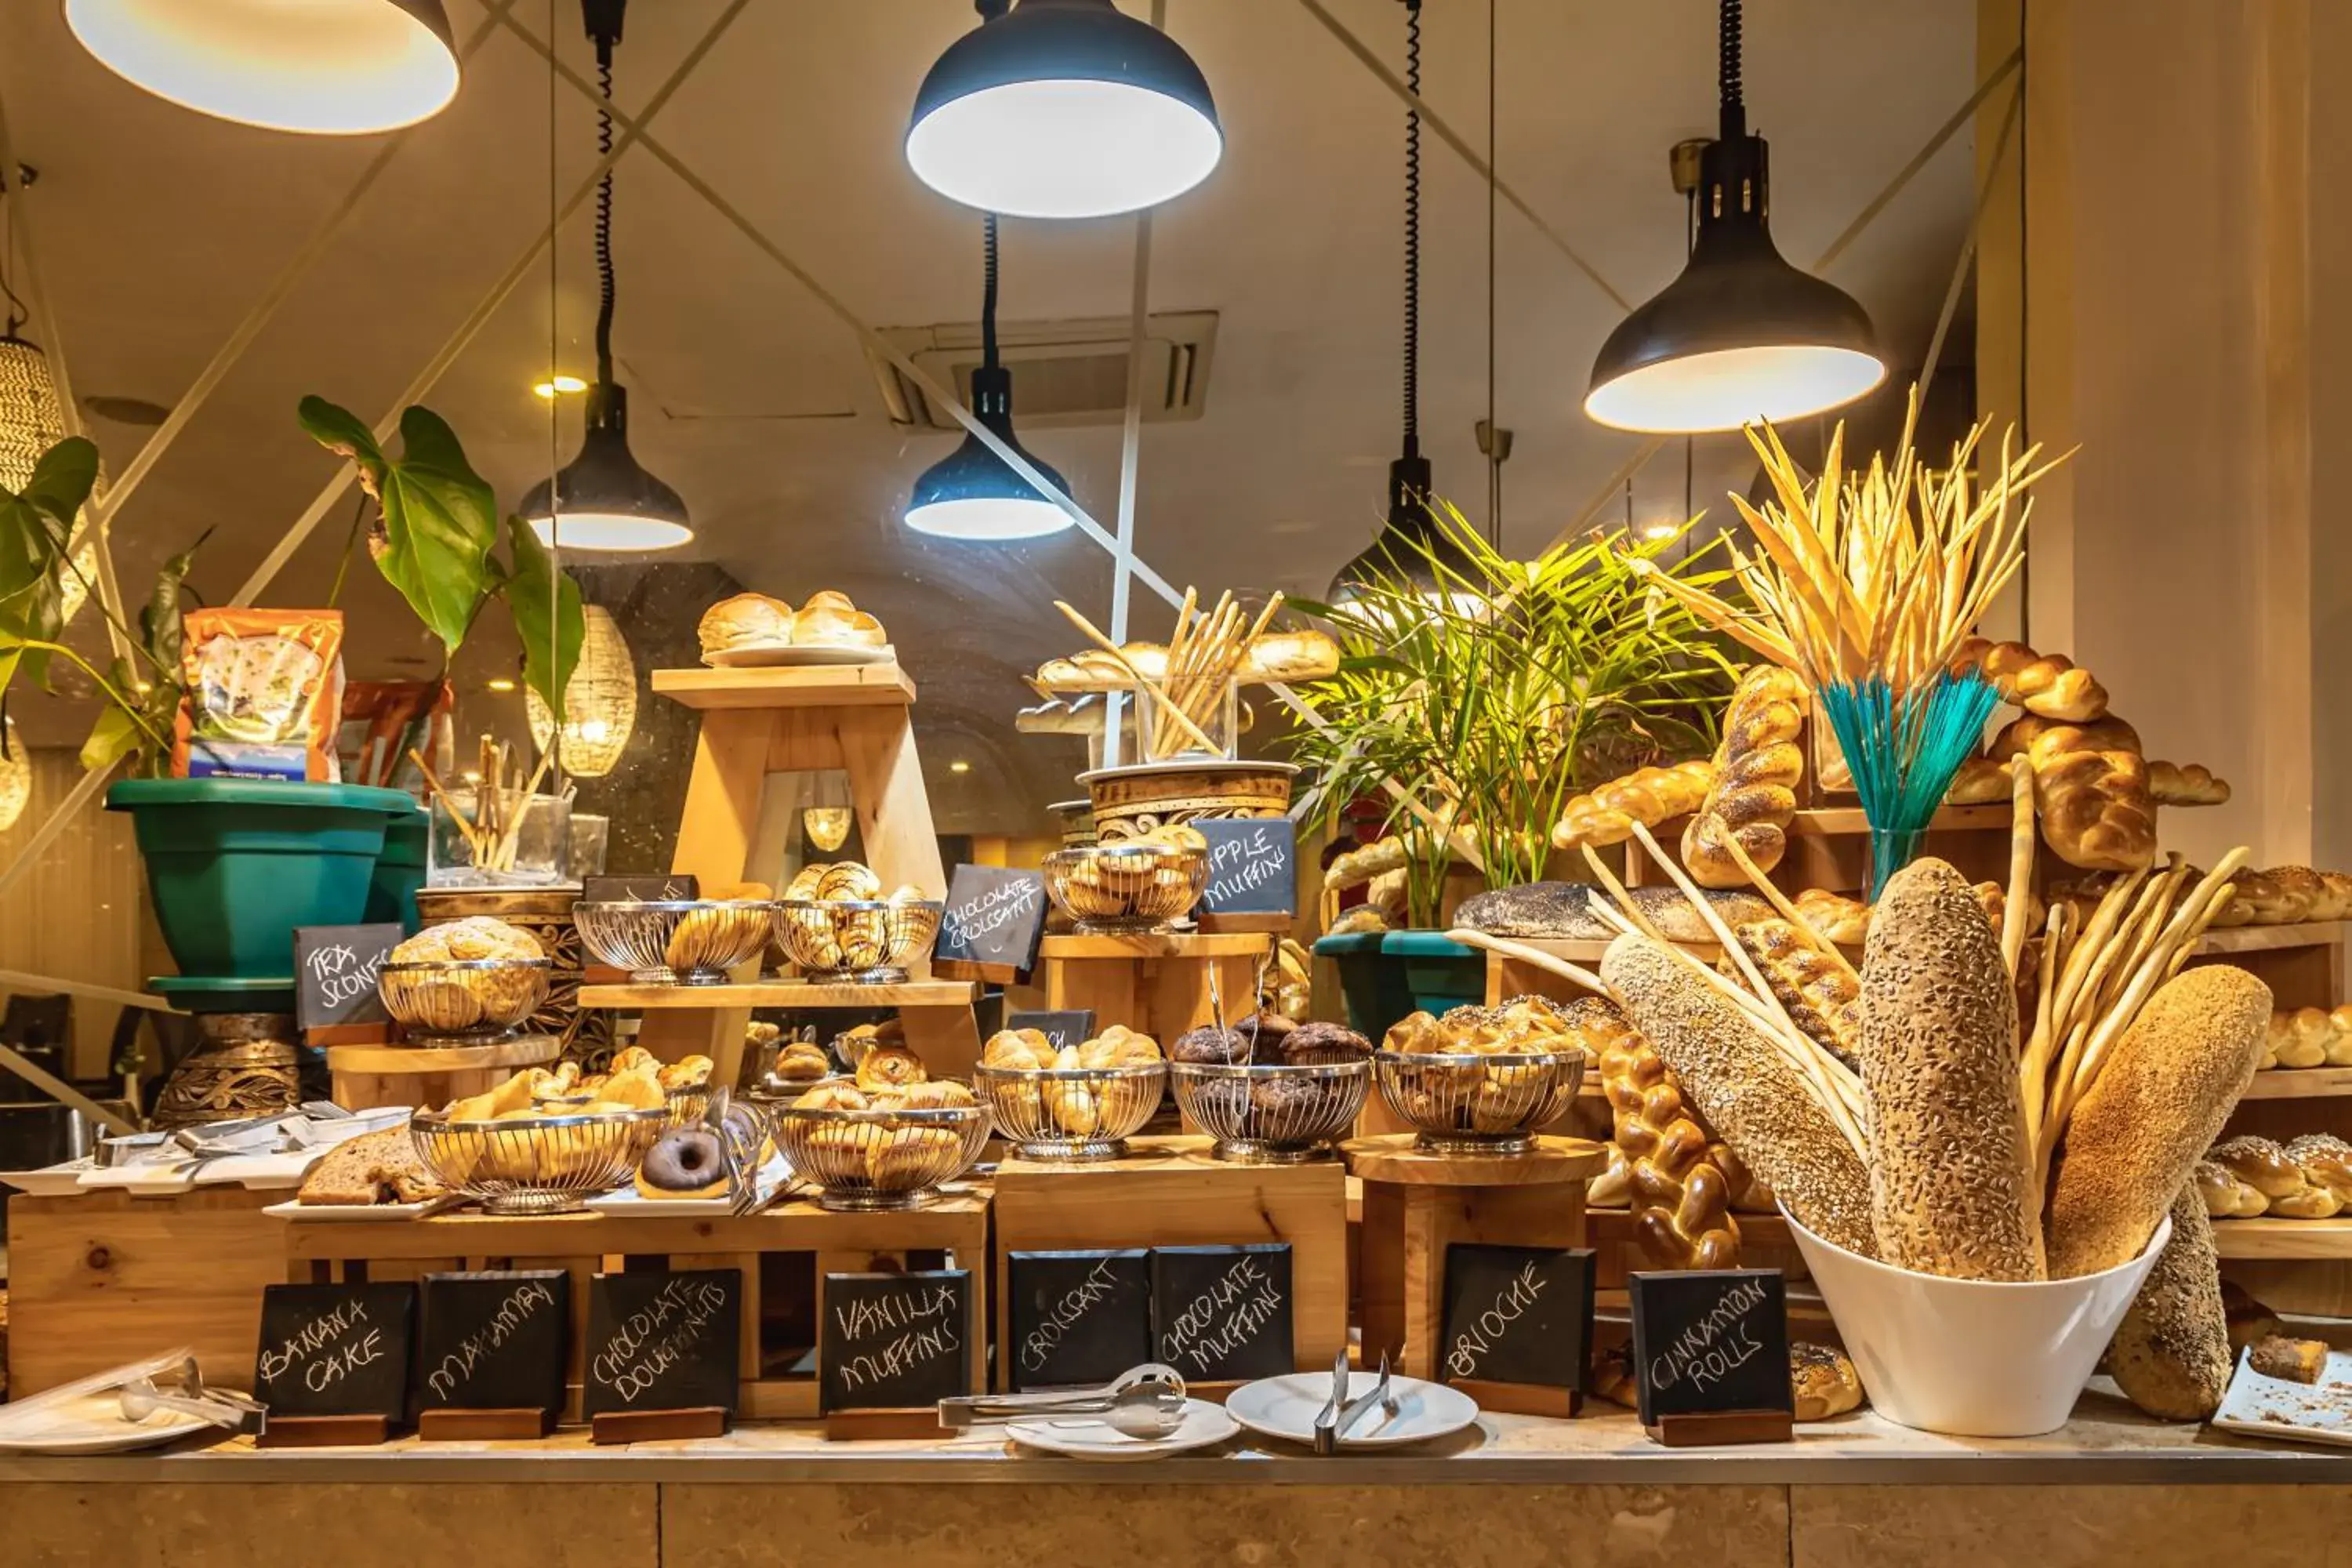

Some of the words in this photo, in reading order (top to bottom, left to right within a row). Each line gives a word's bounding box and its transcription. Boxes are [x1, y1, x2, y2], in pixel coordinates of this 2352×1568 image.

[943, 877, 1031, 931] CHOCOLATE
[307, 943, 357, 982] TEA
[260, 1298, 368, 1385] BANANA
[593, 1277, 698, 1385] CHOCOLATE
[836, 1284, 956, 1341] VANILLA
[1162, 1254, 1266, 1362] CHOCOLATE
[1189, 1276, 1282, 1374] MUFFINS
[1447, 1259, 1548, 1376] BRIOCHE
[1651, 1276, 1766, 1391] CINNAMON
[306, 1327, 385, 1392] CAKE
[840, 1316, 960, 1392] MUFFINS
[1686, 1320, 1763, 1394] ROLLS
